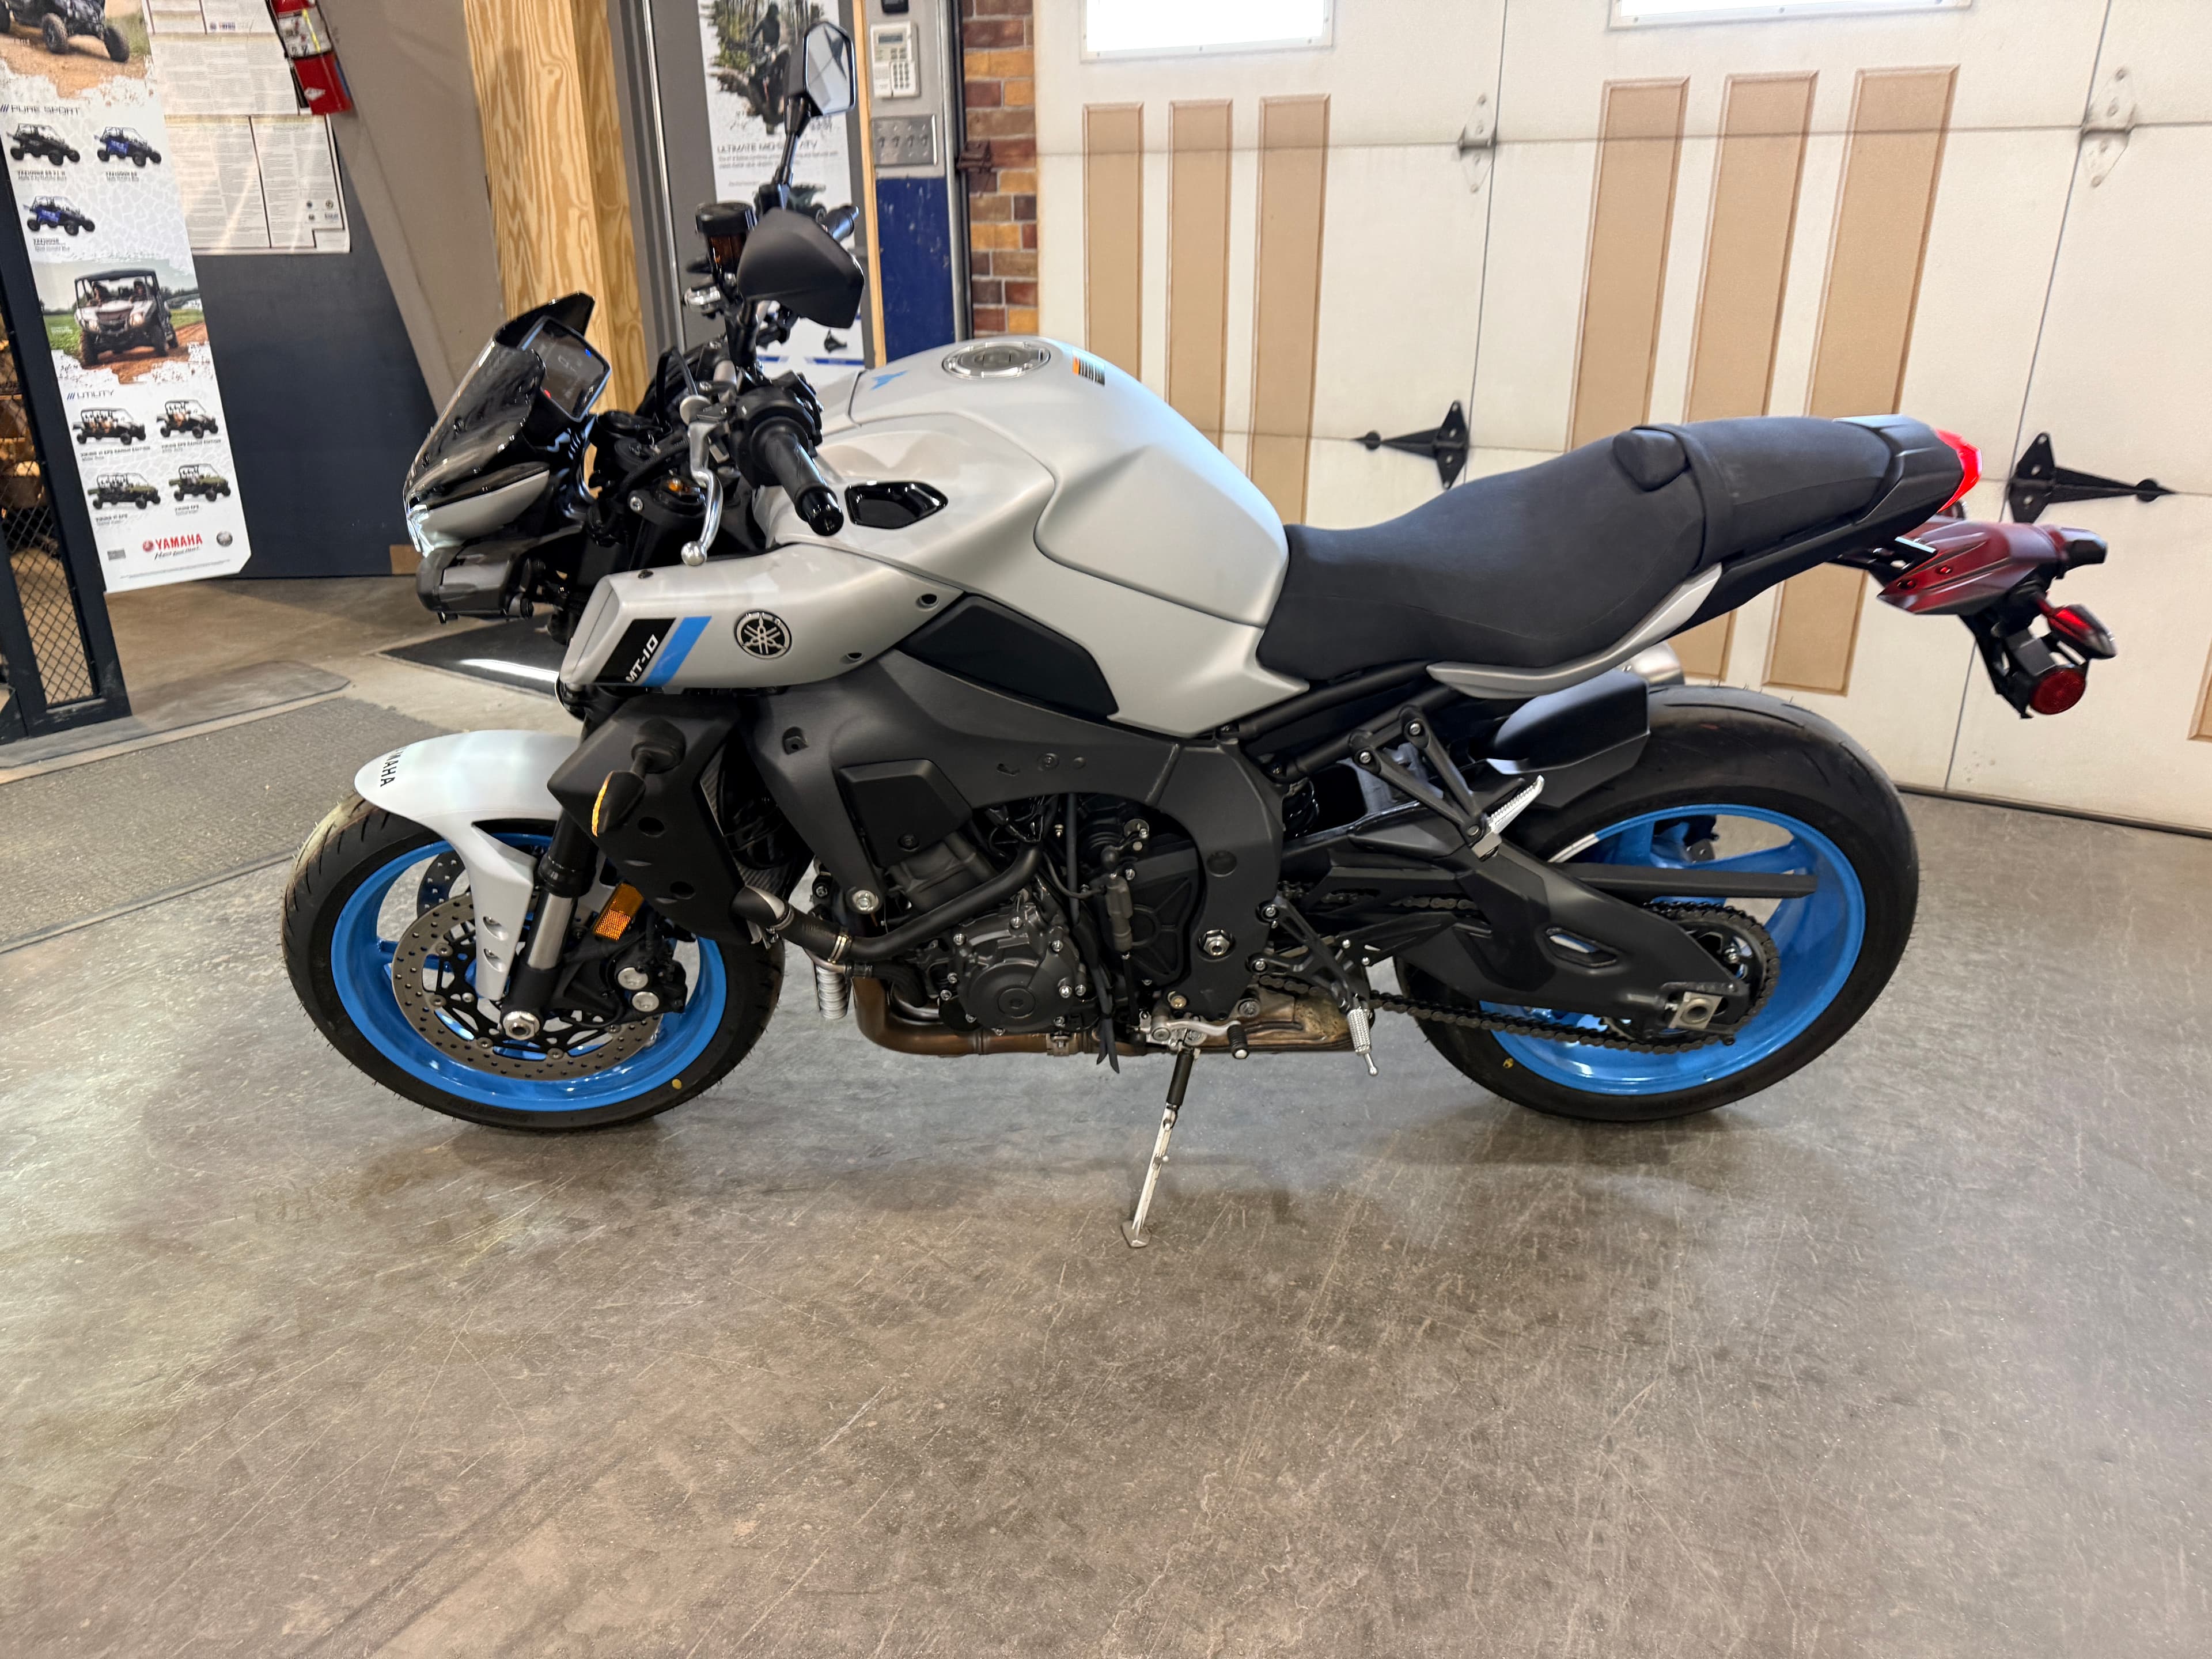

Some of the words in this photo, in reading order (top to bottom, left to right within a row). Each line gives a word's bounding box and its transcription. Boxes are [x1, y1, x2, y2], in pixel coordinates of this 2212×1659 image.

[11, 104, 40, 114] PURE
[44, 105, 81, 116] SPORT
[77, 389, 115, 400] UTILITY
[155, 533, 203, 551] YAMAHA
[626, 634, 658, 683] MT-10
